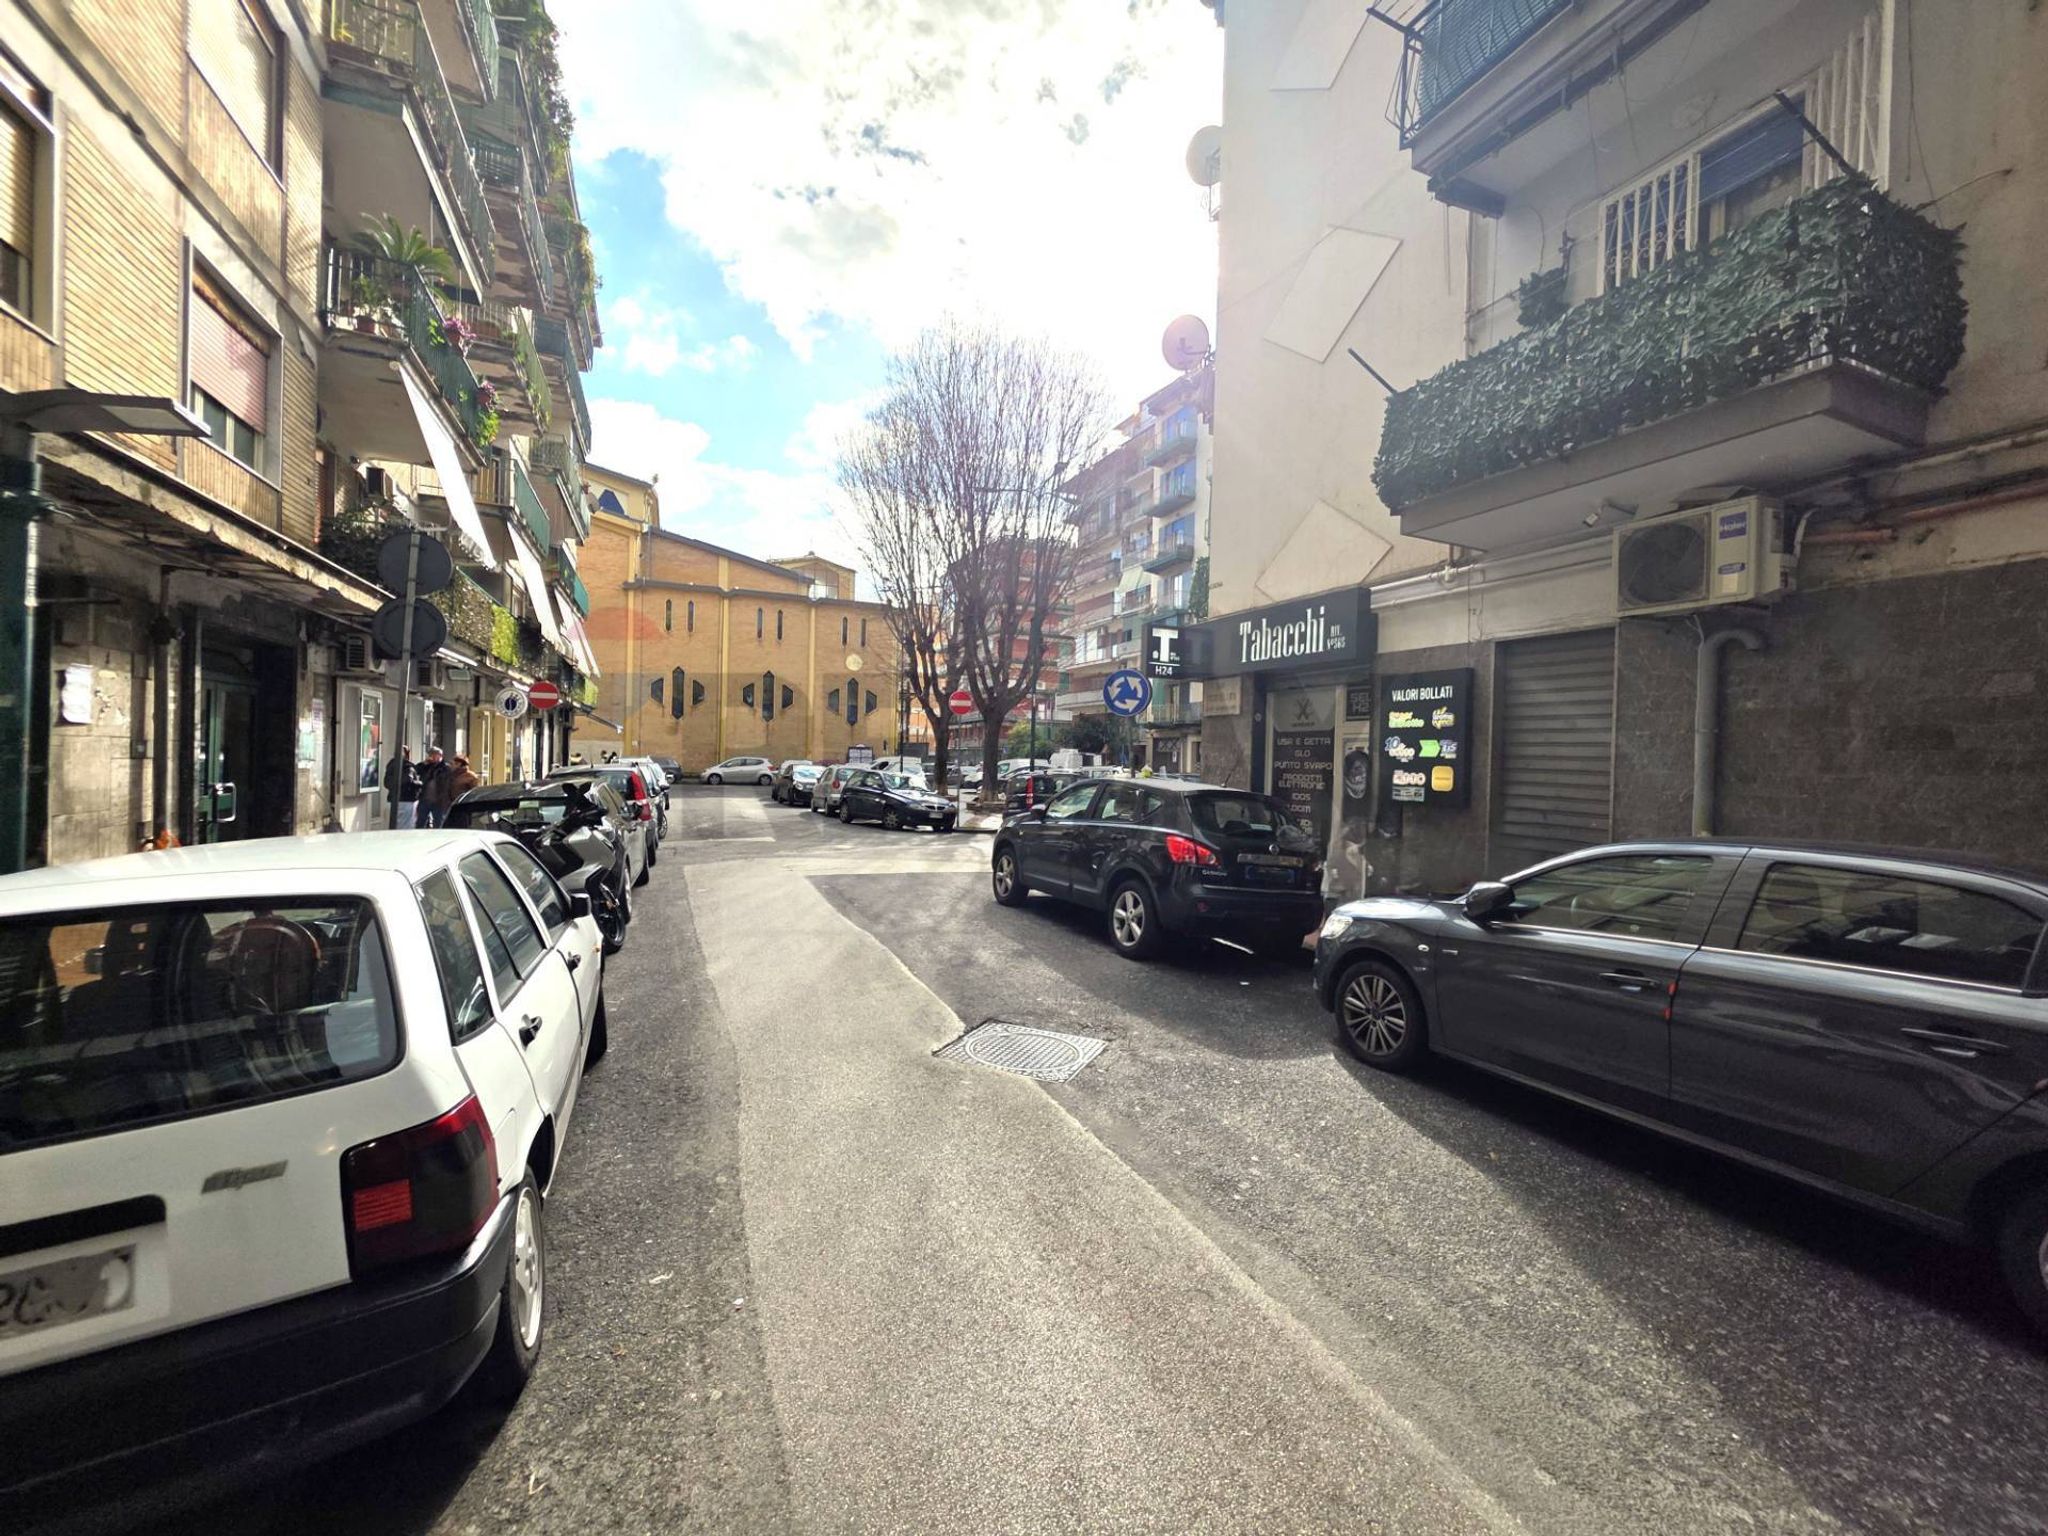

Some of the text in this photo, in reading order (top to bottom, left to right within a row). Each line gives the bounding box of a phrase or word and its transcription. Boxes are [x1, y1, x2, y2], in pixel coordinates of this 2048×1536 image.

[1239, 606, 1326, 664] Tabacchi
[1152, 628, 1179, 662] T
[1155, 666, 1173, 676] H24
[1350, 692, 1371, 703] SEL
[1391, 685, 1453, 702] VALORI BOLLATI
